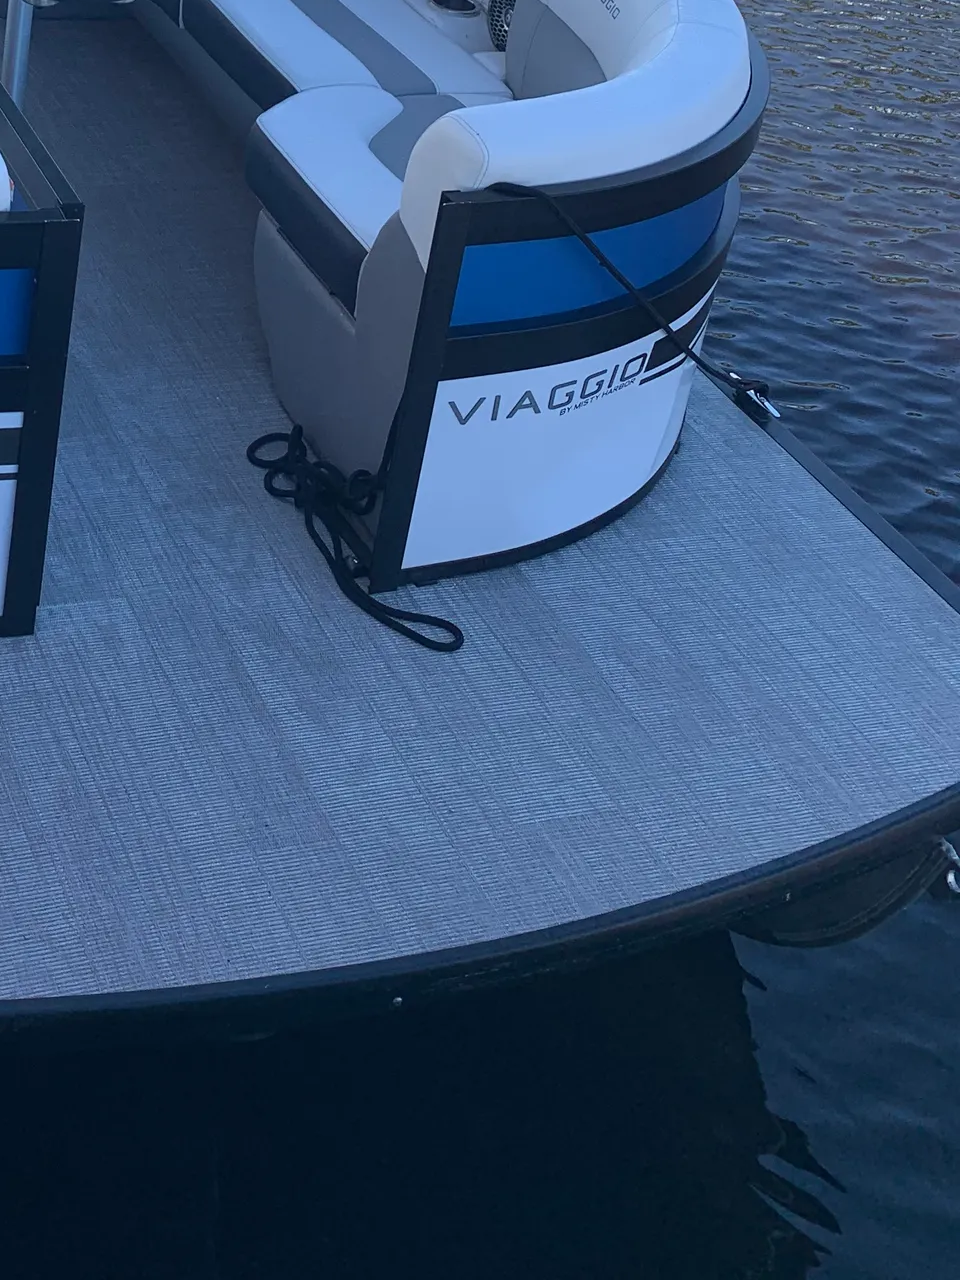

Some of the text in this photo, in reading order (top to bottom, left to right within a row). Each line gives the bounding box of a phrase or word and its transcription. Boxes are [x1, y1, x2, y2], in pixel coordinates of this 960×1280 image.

[448, 352, 647, 425] VIAGGIO
[559, 377, 636, 416] BY MISTY HARBOR
